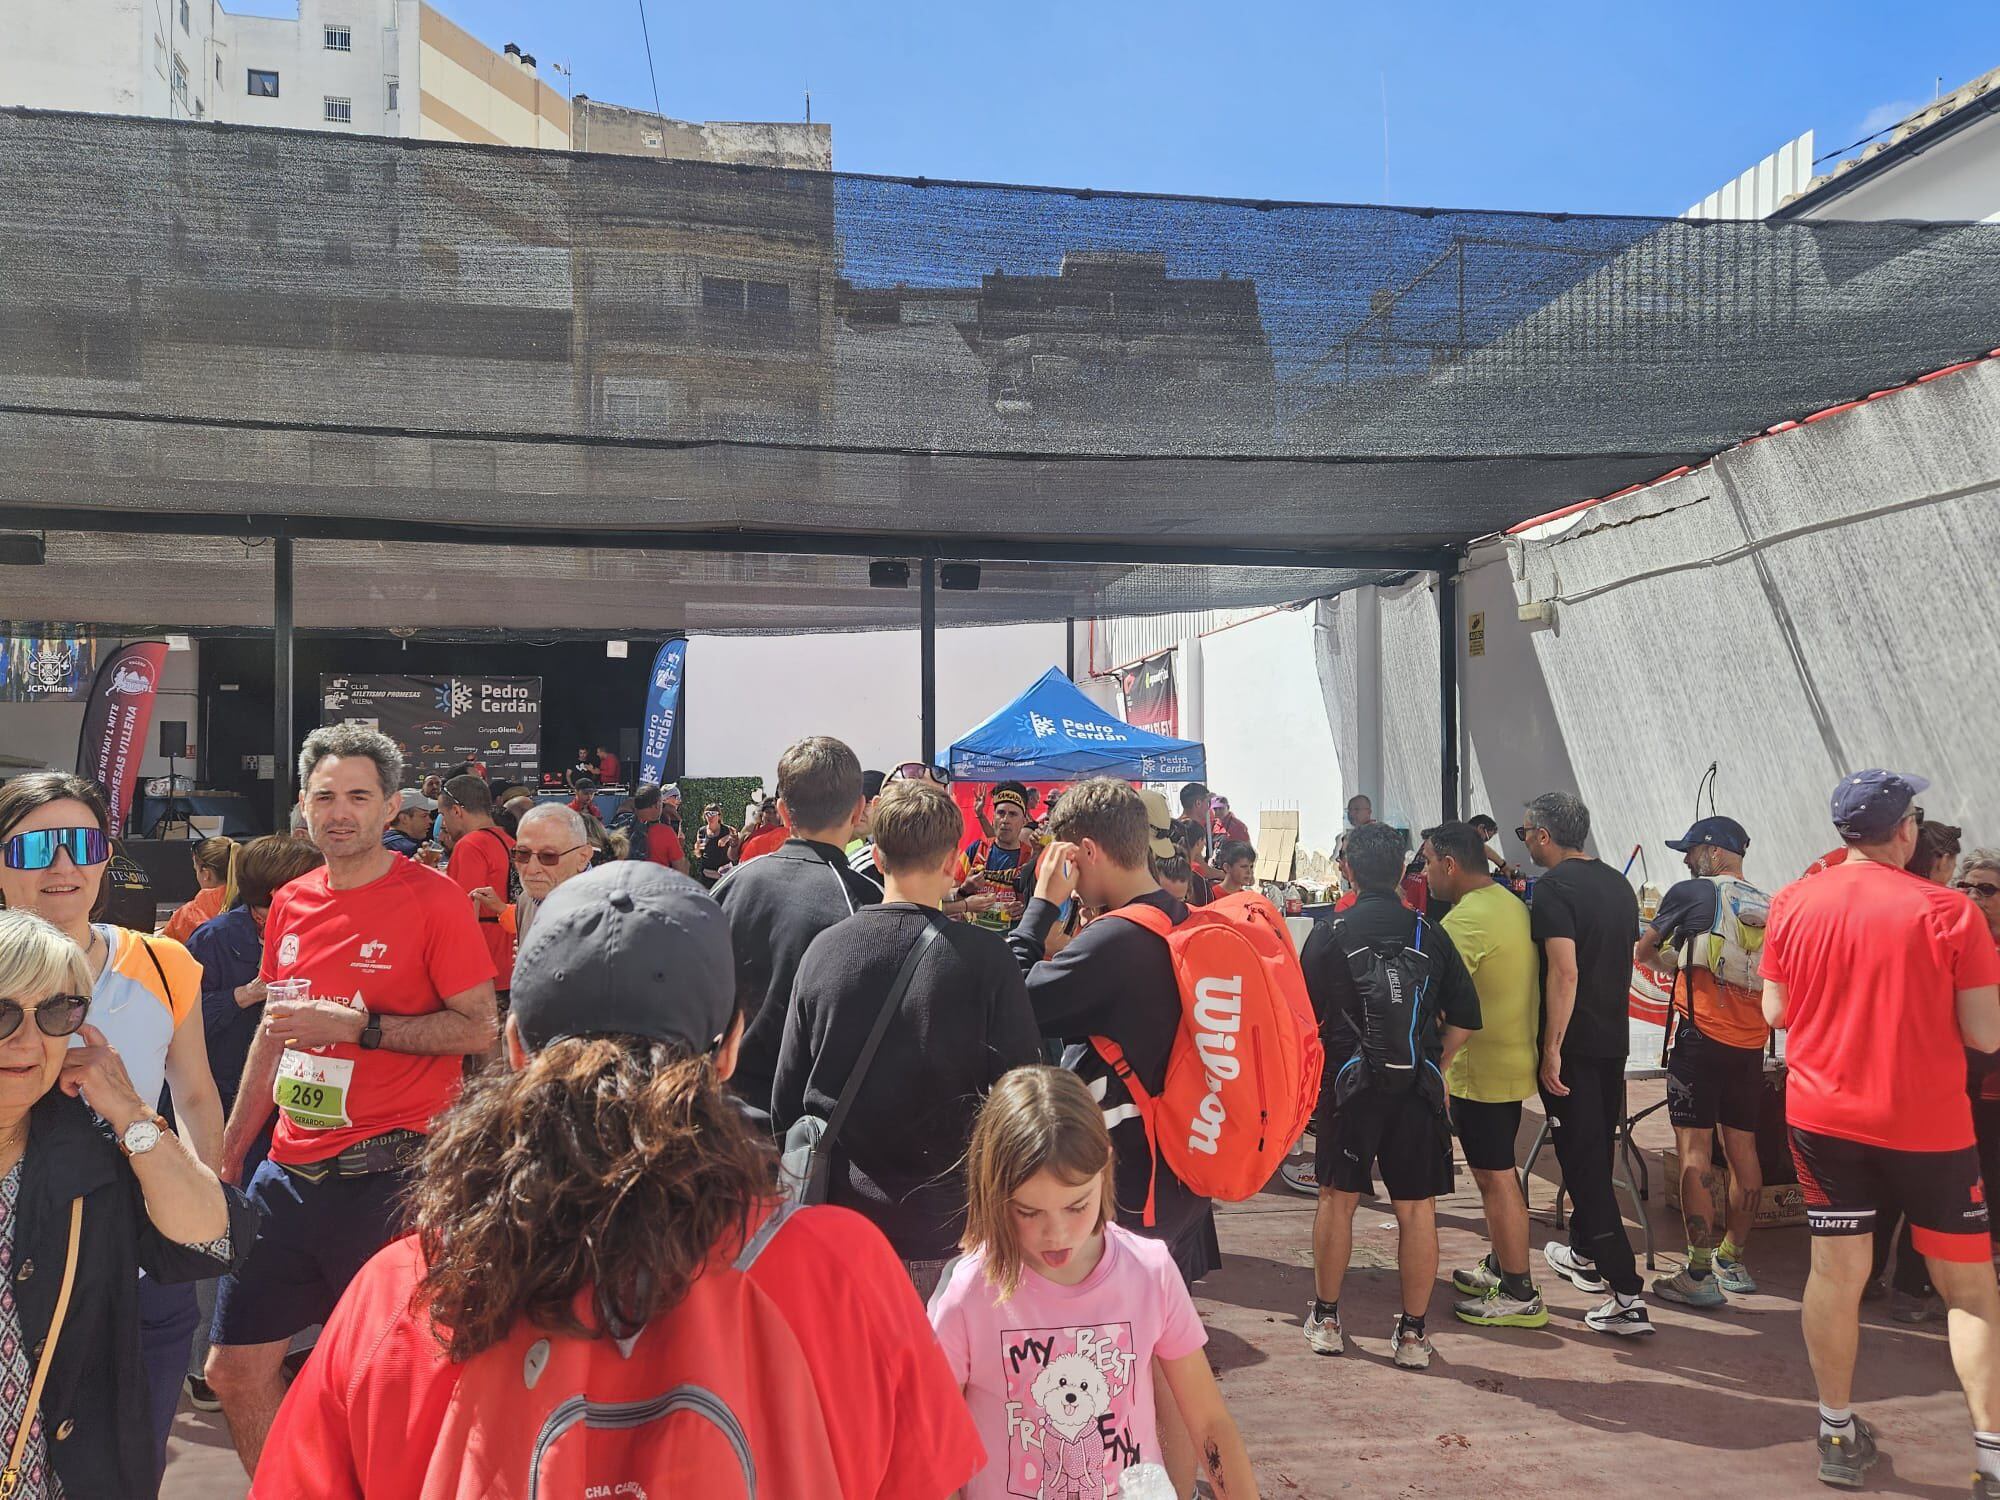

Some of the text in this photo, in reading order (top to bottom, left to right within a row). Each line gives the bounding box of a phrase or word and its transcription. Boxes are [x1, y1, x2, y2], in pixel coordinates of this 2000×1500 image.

[27, 684, 73, 693] JCFVillena
[481, 684, 528, 698] Pedro
[481, 698, 537, 713] Cerdán
[107, 703, 120, 735] LMITE
[1062, 718, 1113, 733] Pedro
[646, 714, 659, 756] Pedro
[651, 709, 674, 758] Cerdán
[1066, 728, 1128, 741] Cerdán
[102, 736, 113, 755] HAY
[100, 755, 109, 768] NO
[110, 756, 127, 817] PROMESAS
[119, 705, 138, 756] VILLENA
[1160, 756, 1188, 764] Pedro
[1160, 764, 1193, 774] Cerdán
[1386, 968, 1403, 1004] CAMELBAK
[1186, 974, 1242, 1156] Wilson
[291, 1084, 324, 1108] 269
[294, 1115, 325, 1127] GERARDO
[1010, 1336, 1055, 1374] MY
[1076, 1328, 1137, 1386] BEST
